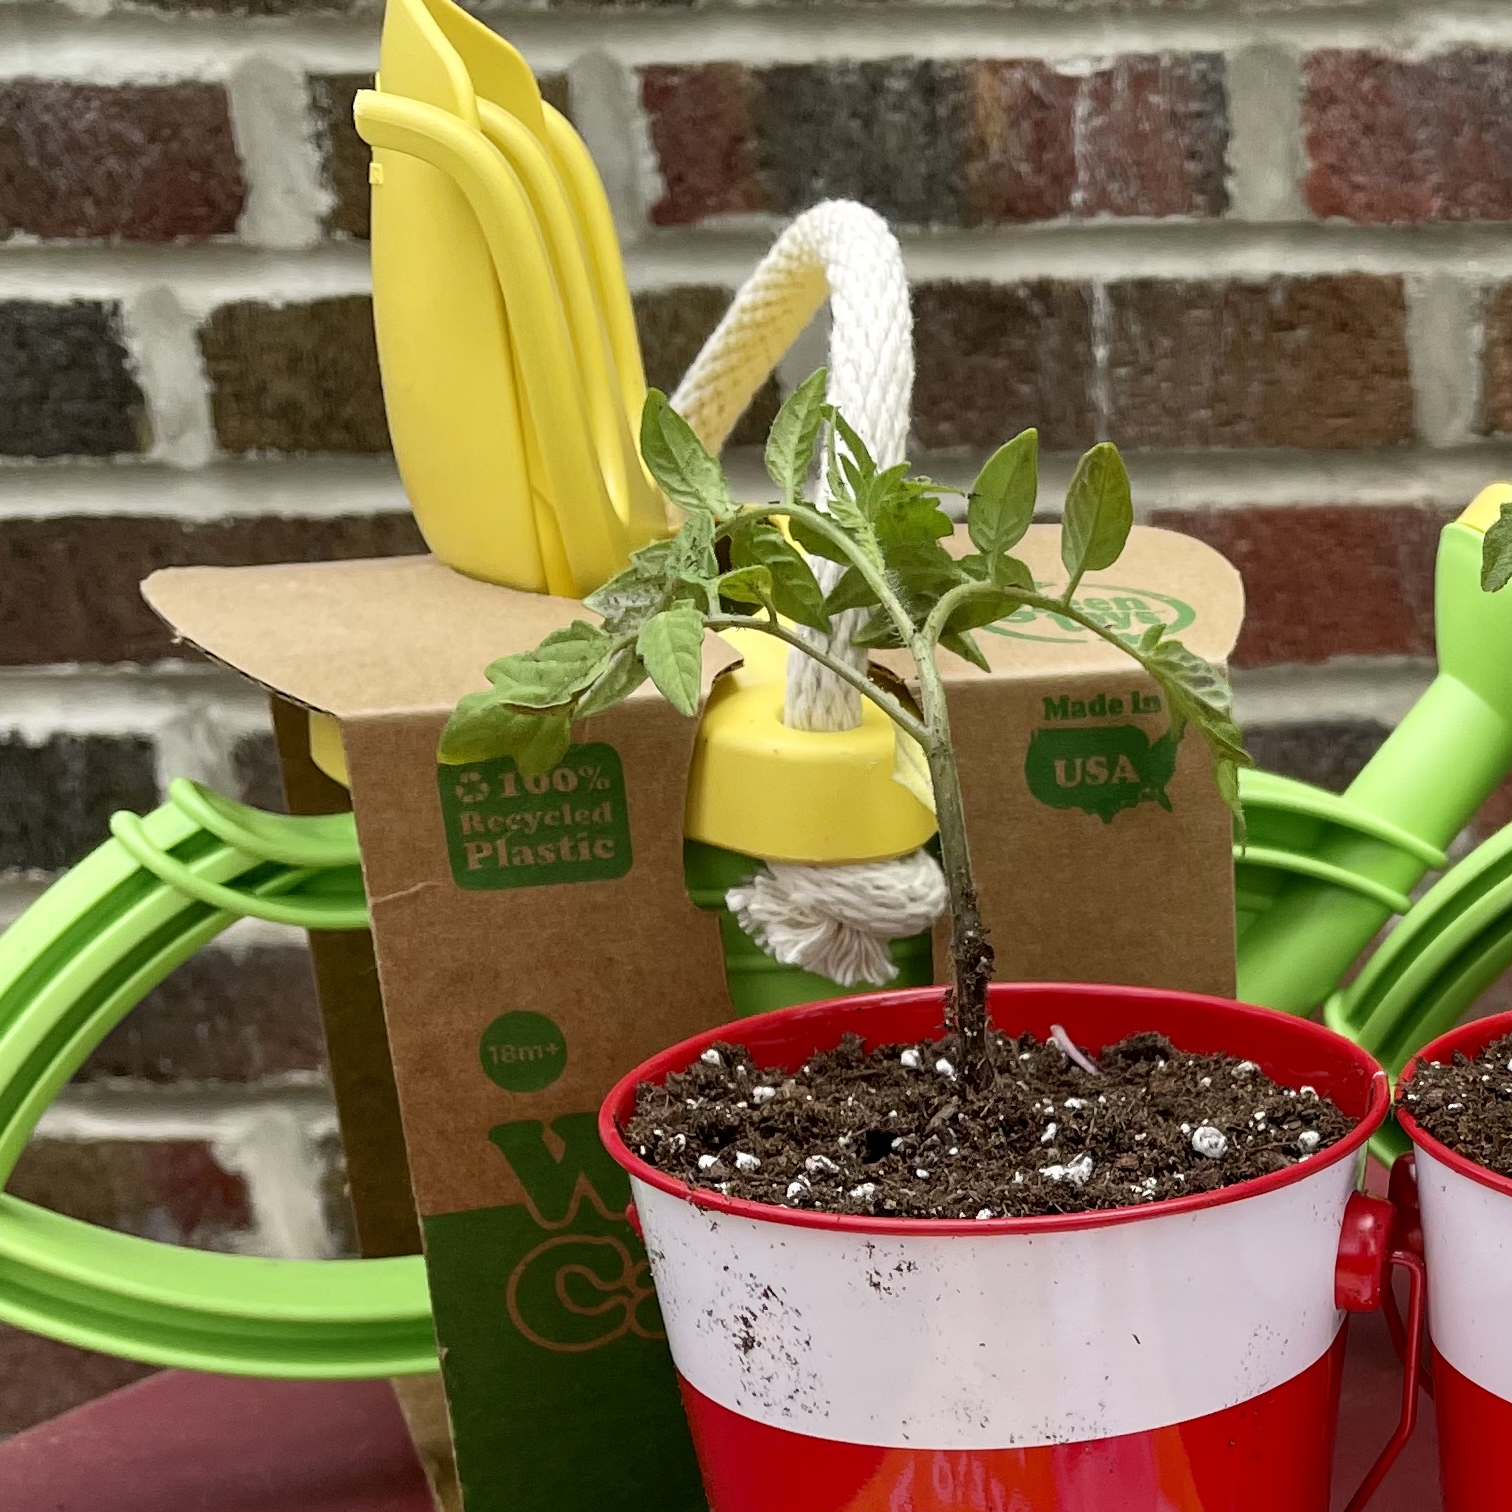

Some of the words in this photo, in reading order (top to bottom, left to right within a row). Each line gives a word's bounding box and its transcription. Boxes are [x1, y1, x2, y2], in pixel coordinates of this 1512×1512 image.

[1041, 693, 1124, 721] Made
[498, 765, 611, 798] 100%
[1054, 754, 1141, 787] USA
[459, 801, 613, 835] Recycled
[464, 832, 616, 871] Plastic
[488, 1042, 561, 1065] 18m+
